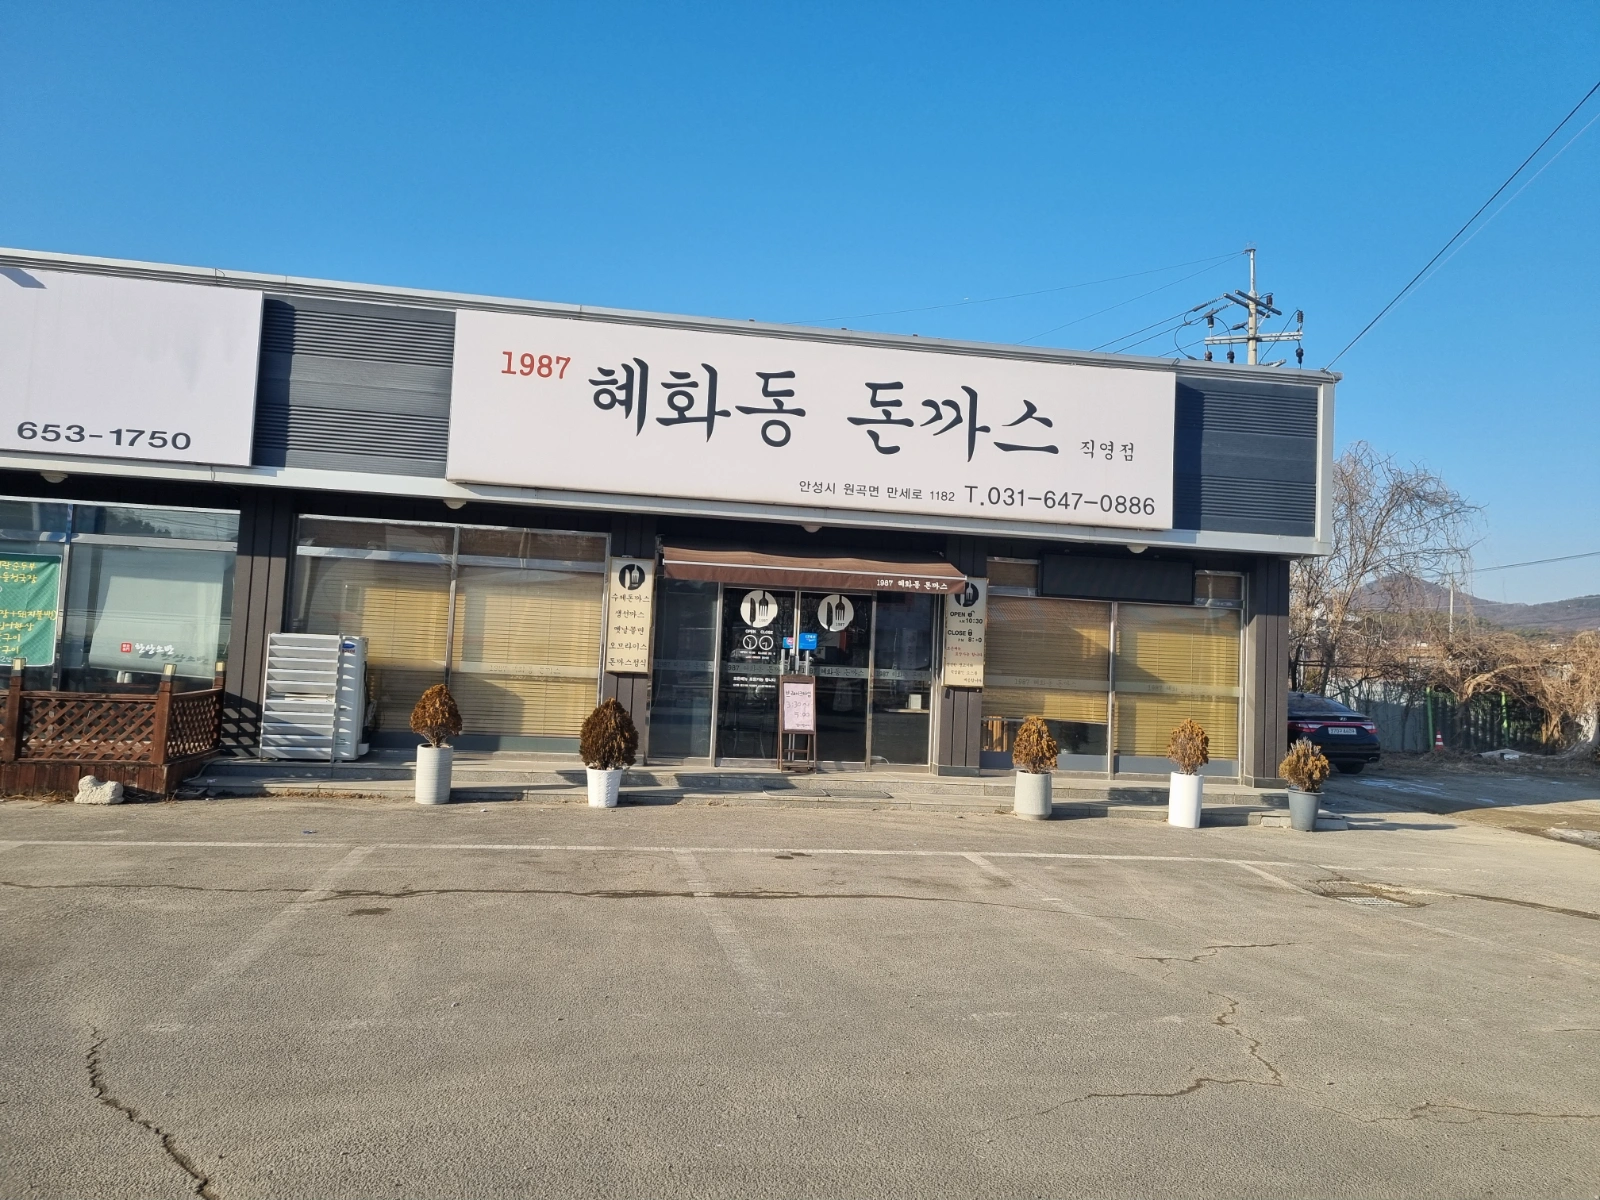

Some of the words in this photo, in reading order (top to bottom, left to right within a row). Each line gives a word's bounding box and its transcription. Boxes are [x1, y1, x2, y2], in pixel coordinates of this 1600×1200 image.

[501, 351, 571, 379] 1987
[588, 357, 806, 447] 혜화동
[847, 381, 1059, 462] 돈까스
[1080, 439, 1135, 462] 직영점
[17, 421, 191, 450] 653-1750
[799, 480, 836, 495] 안성시
[843, 483, 880, 497] 원곡면
[887, 486, 923, 500] 만세로
[929, 491, 955, 502] 1182
[964, 485, 1155, 516] T.031-647-0886
[0, 561, 36, 571] 란순두부
[877, 579, 893, 587] 1987
[898, 580, 920, 589] 혜화동
[924, 581, 948, 590] 돈까스
[615, 609, 645, 618] 생선까스
[135, 642, 174, 655] 한상소반
